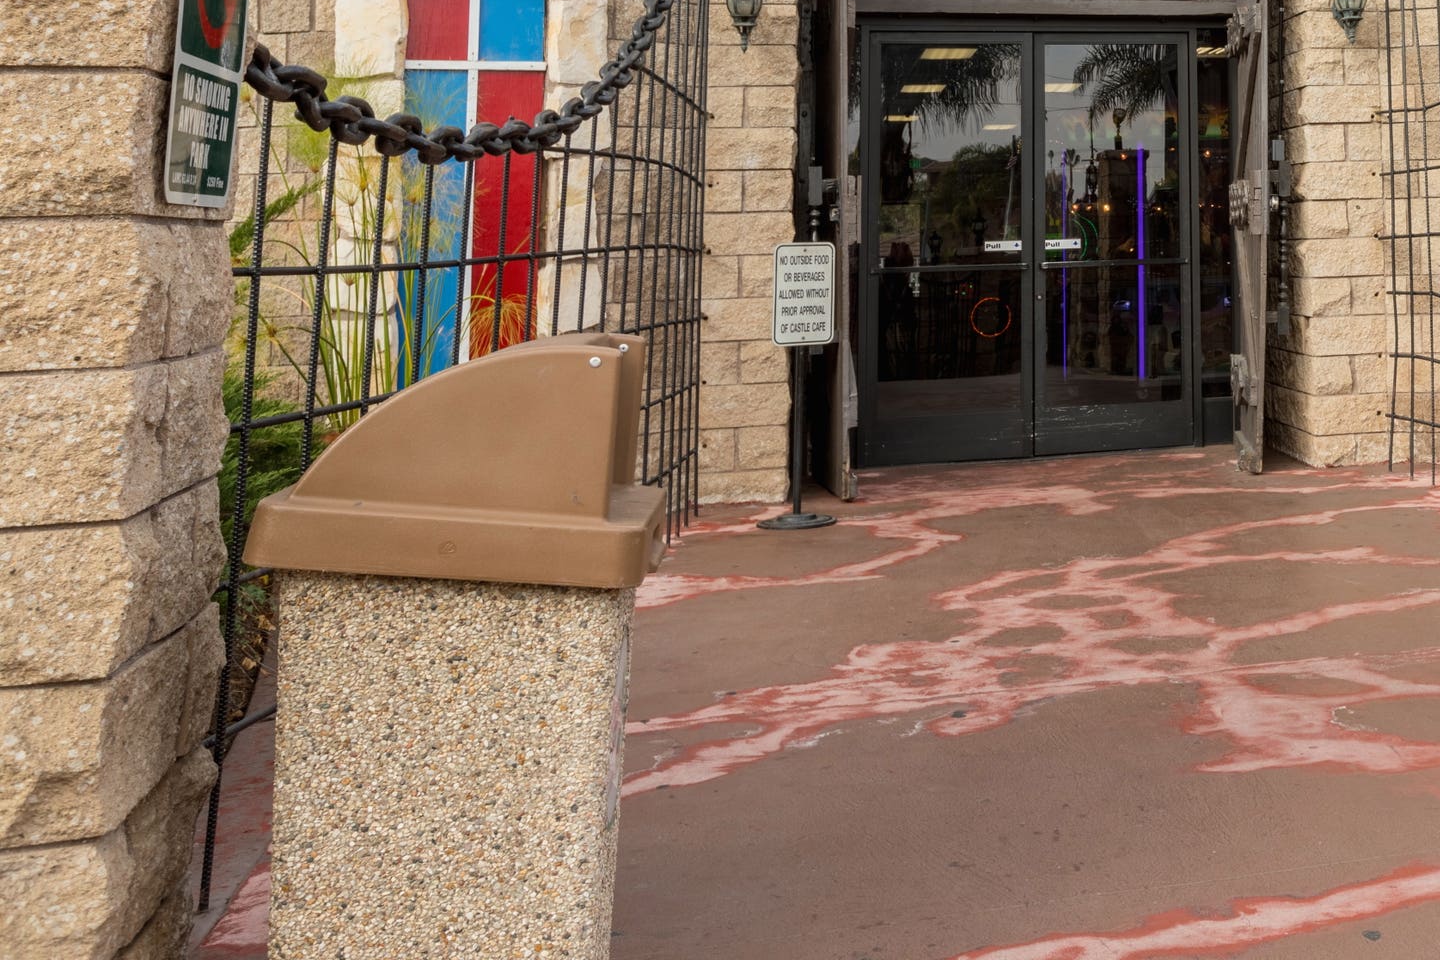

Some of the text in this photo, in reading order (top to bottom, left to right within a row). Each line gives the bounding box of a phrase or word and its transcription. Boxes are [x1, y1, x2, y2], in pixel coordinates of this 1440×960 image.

[183, 72, 231, 112] NO SMOKING
[177, 105, 229, 142] ANYWHERE IN
[189, 141, 211, 170] PARK
[780, 255, 829, 265] NO OUTSIDE FOOD
[784, 272, 825, 282] OR BEVERAGES
[779, 289, 829, 299] ALLOWED WITHOUT
[781, 306, 825, 316] PRIOR APPROVAL
[781, 322, 826, 333] OF CASTLE CAFE
